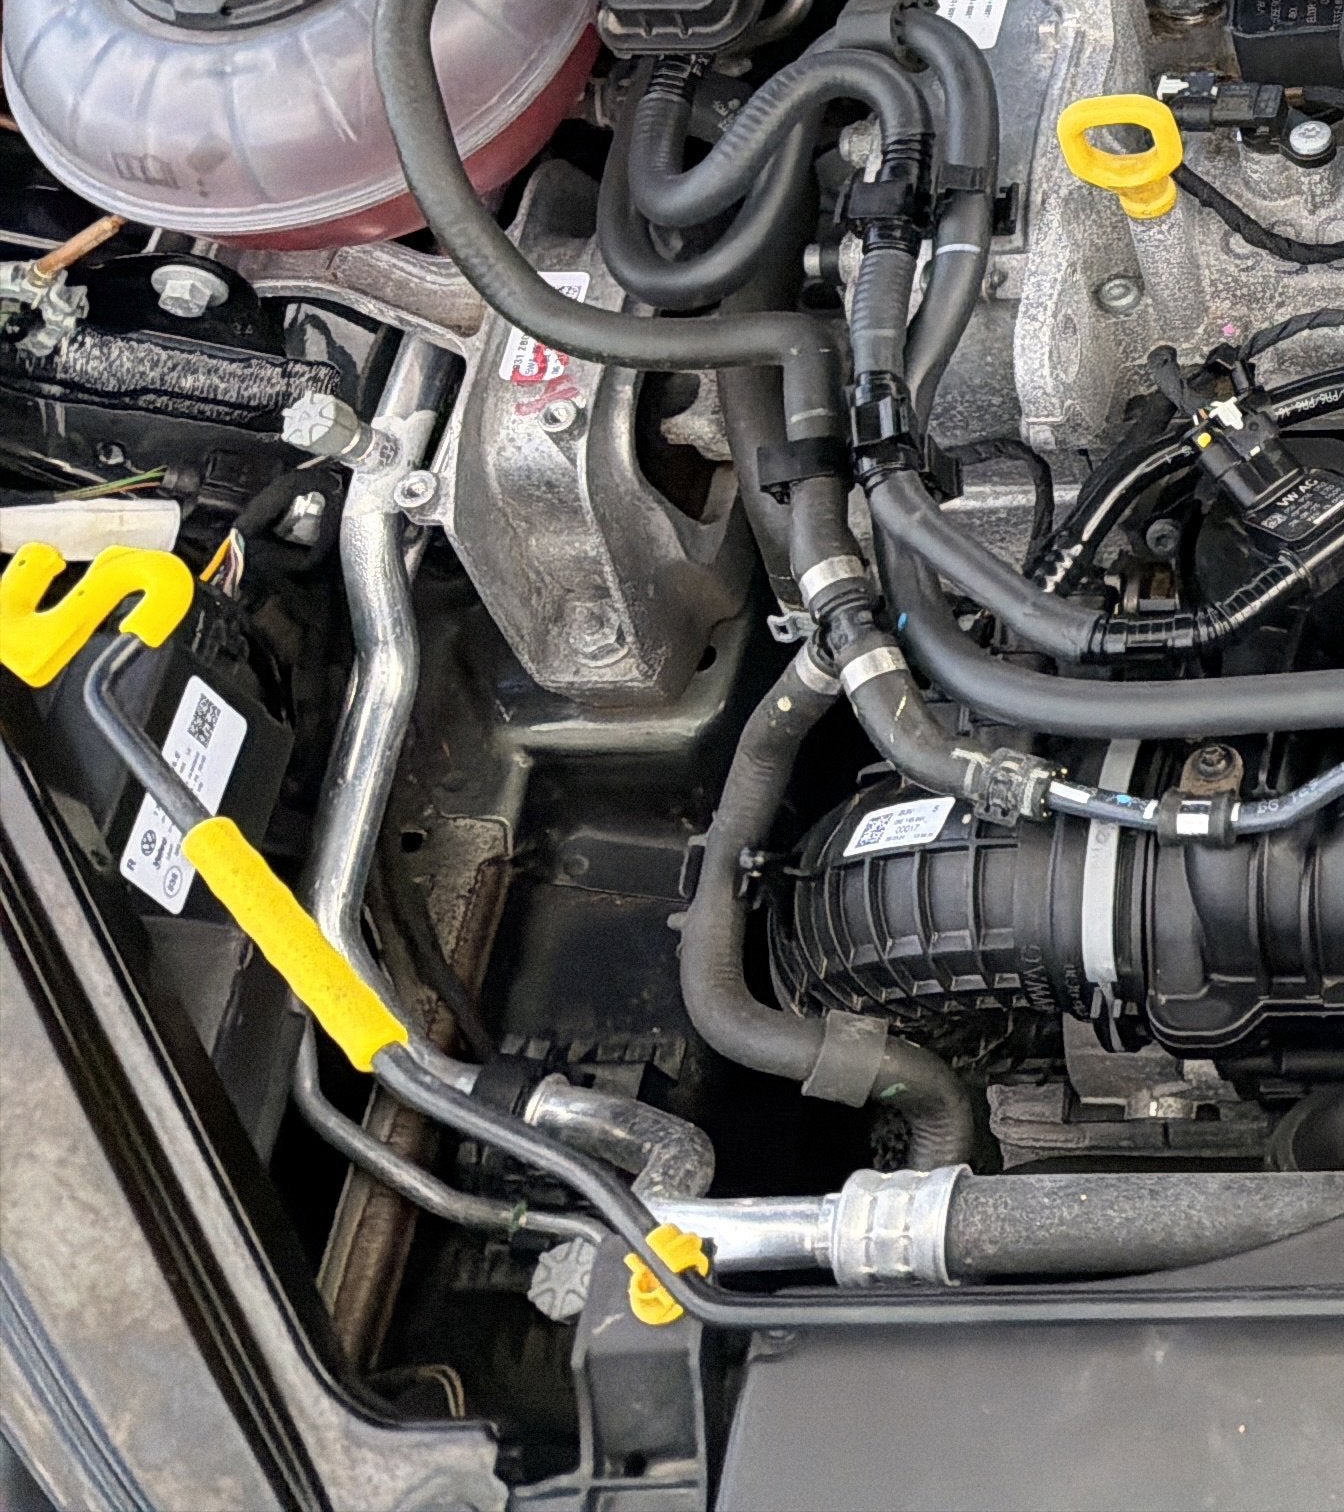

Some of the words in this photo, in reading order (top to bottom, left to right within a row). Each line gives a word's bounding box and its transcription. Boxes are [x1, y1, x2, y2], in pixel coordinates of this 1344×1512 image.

[1275, 489, 1299, 510] VW
[1297, 474, 1319, 494] AG
[124, 857, 137, 872] R
